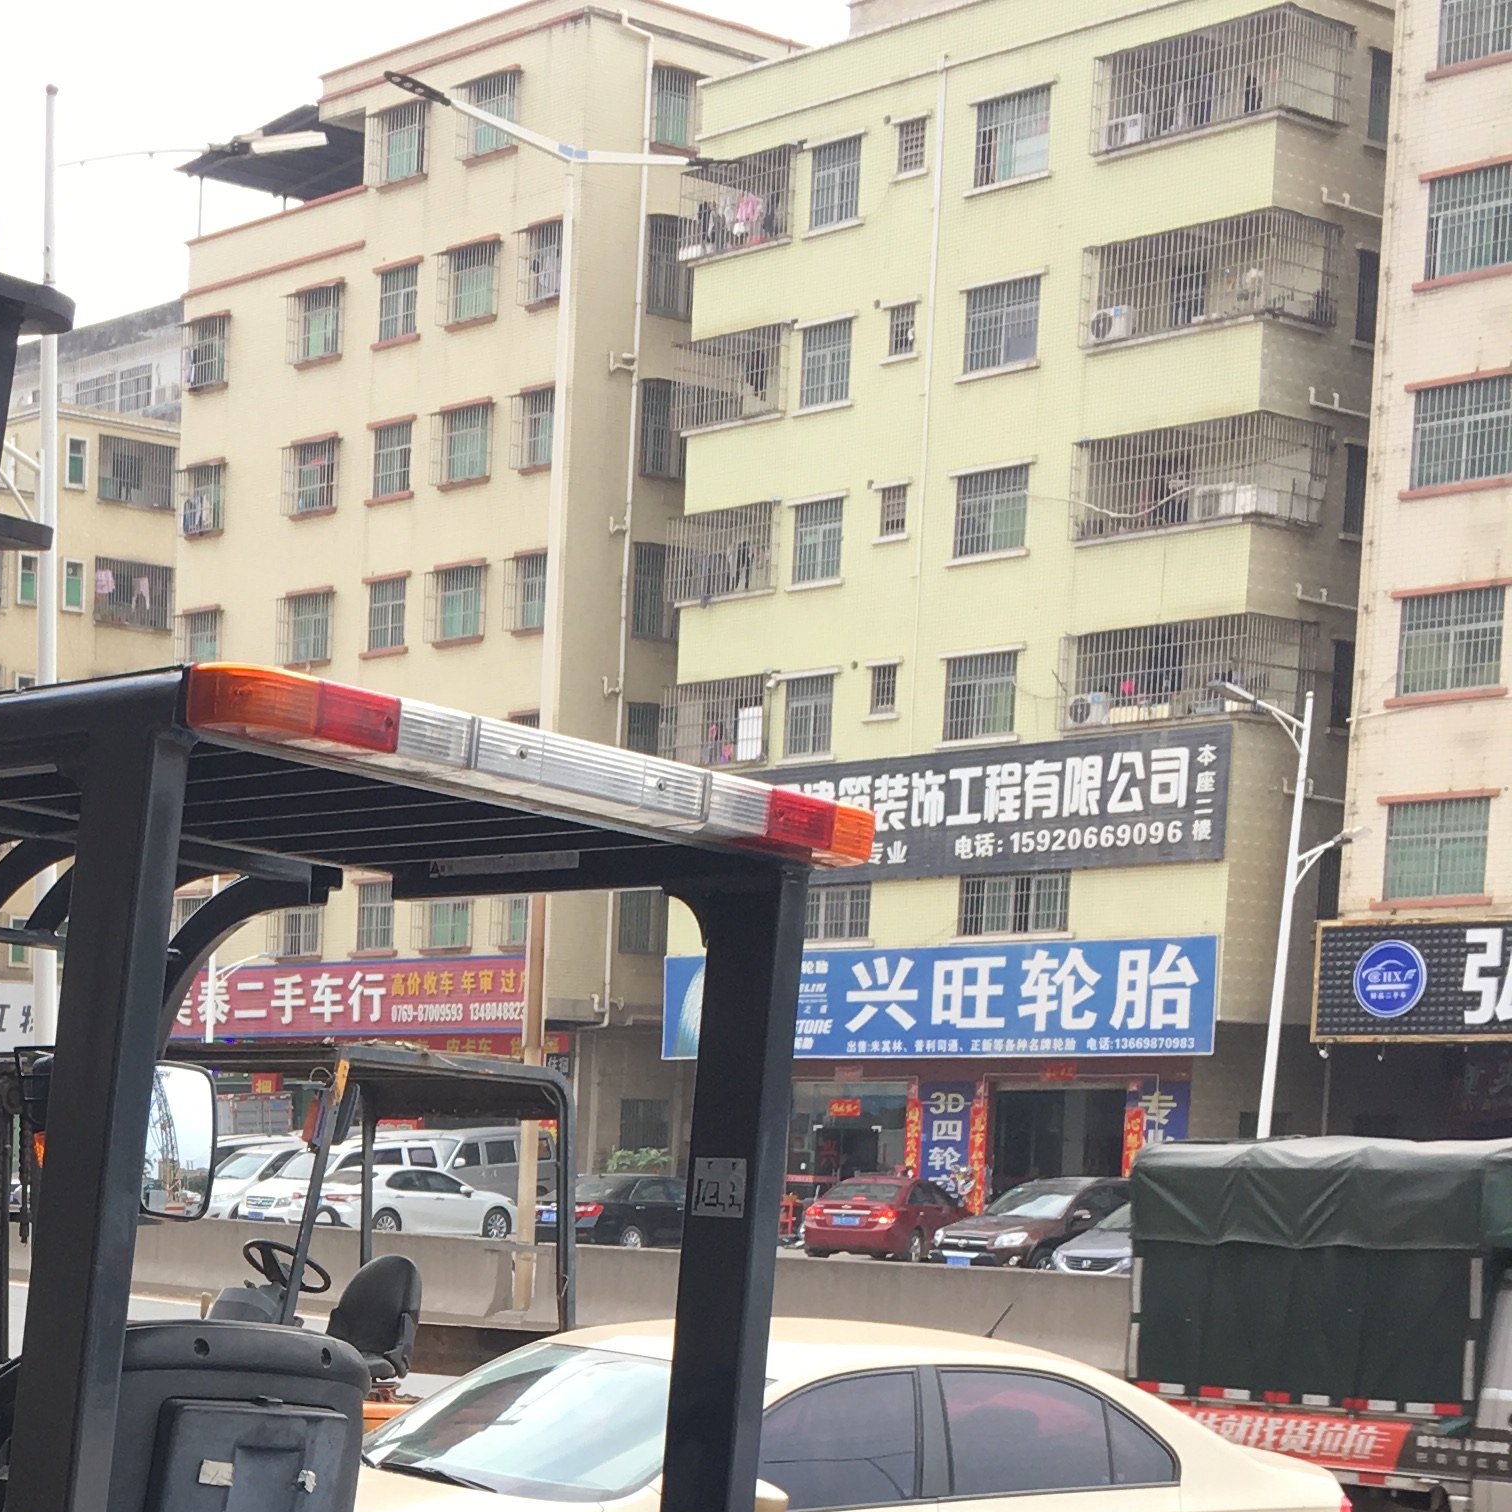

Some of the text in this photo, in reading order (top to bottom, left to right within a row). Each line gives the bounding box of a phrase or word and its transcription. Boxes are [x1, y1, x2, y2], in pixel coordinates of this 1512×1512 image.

[391, 971, 454, 997] 高价收车
[845, 943, 1200, 1034] 兴旺轮胎
